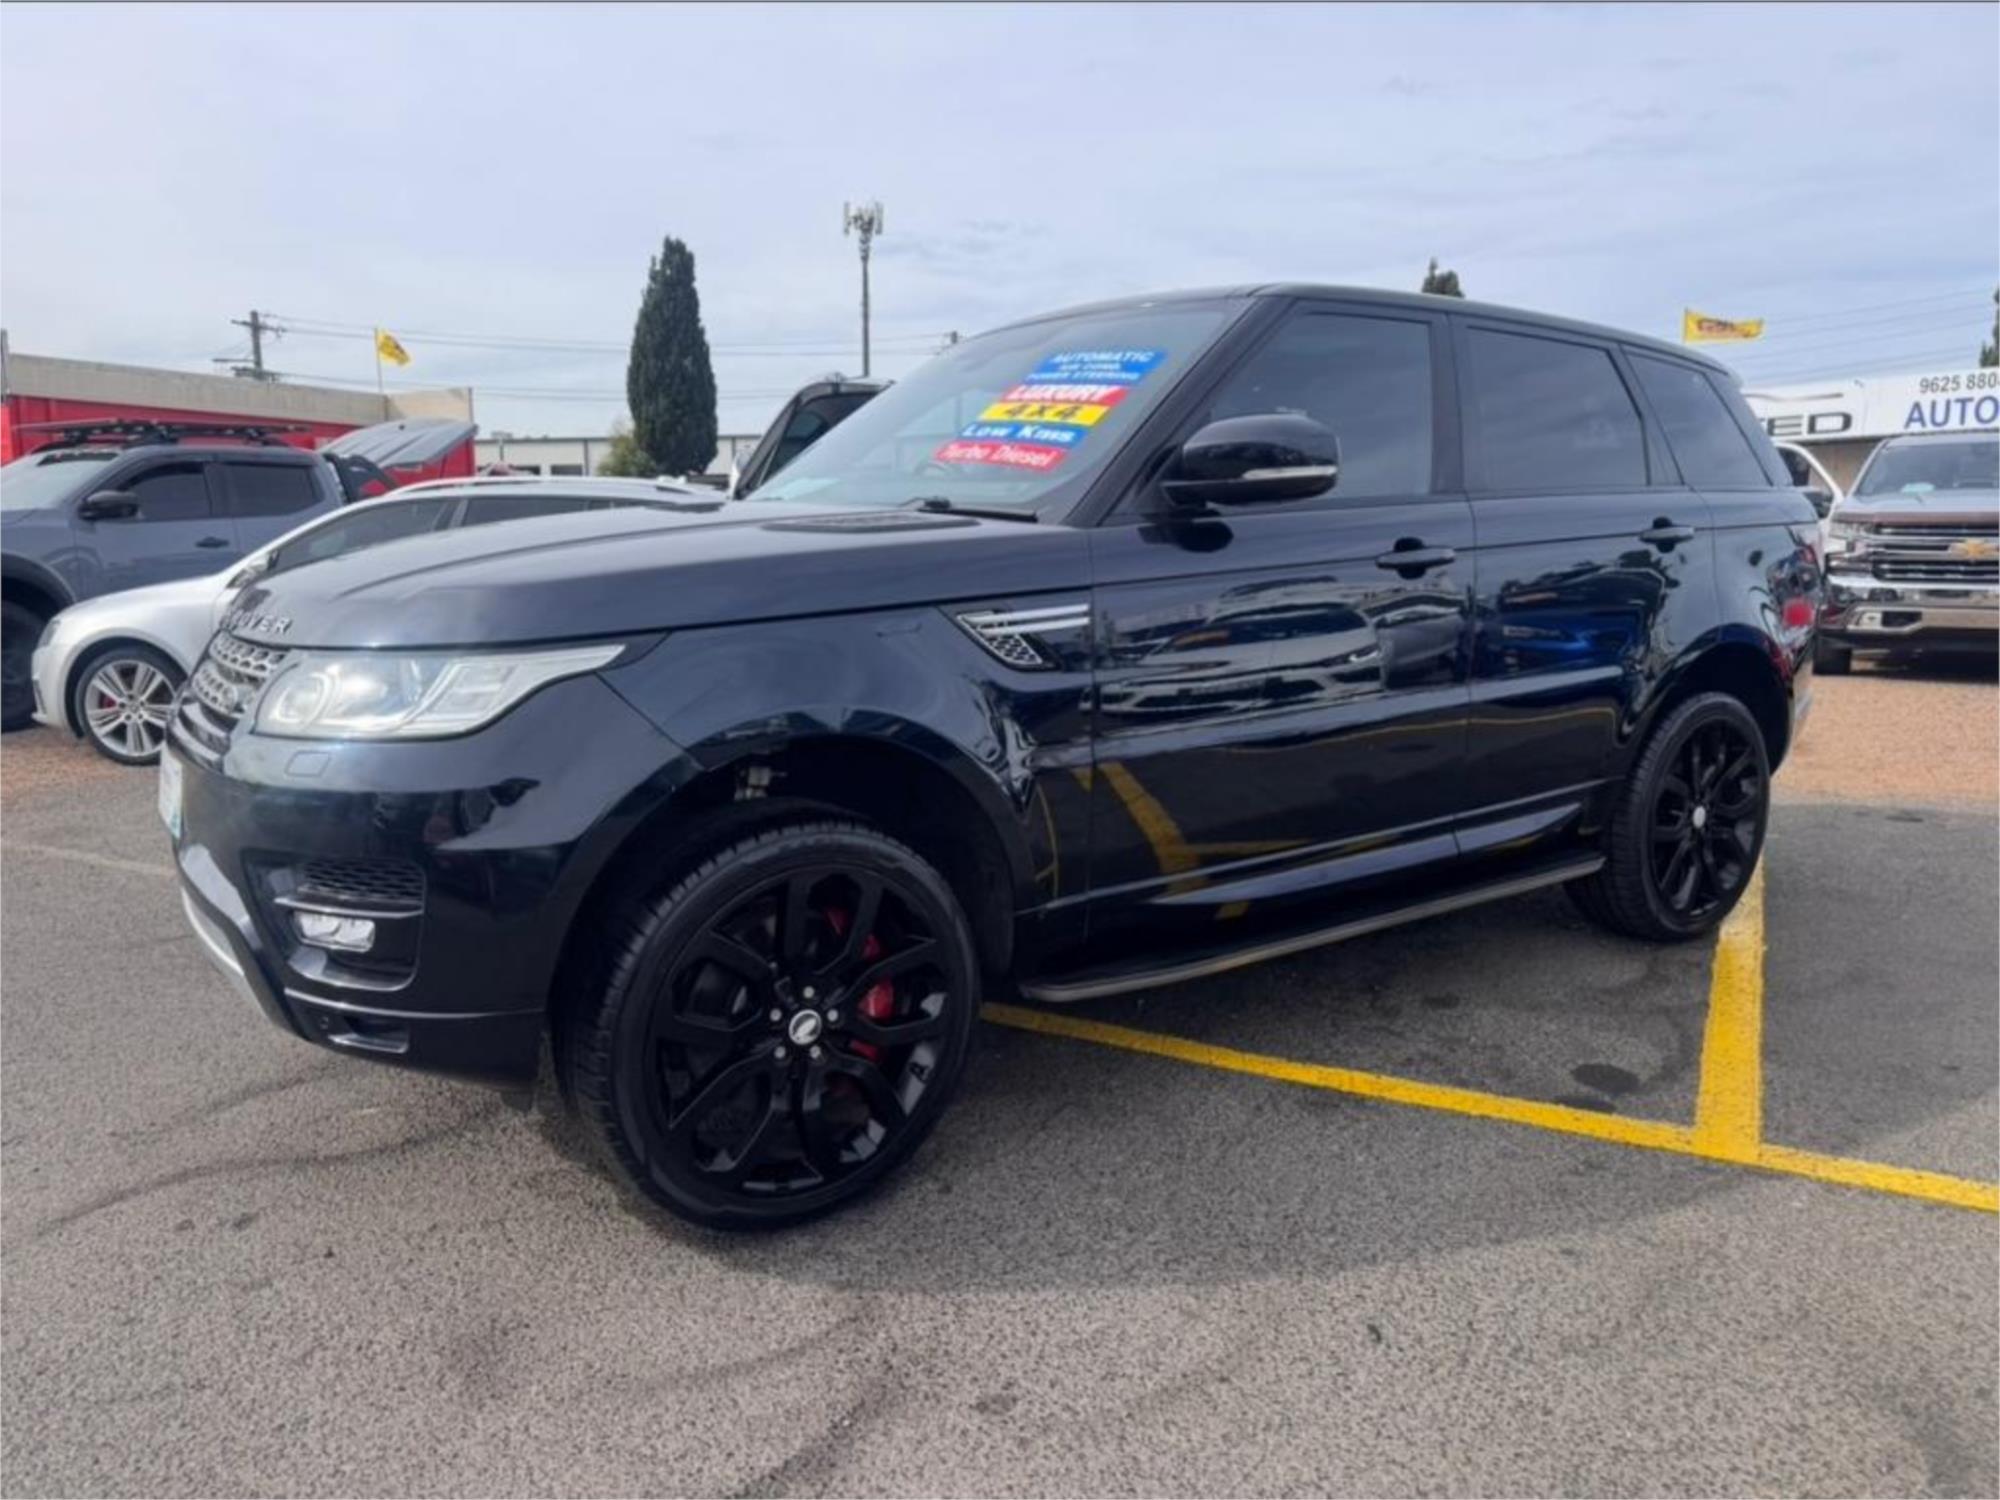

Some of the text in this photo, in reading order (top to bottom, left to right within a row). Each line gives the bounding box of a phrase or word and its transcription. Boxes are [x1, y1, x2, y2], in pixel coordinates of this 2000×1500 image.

[1052, 351, 1155, 363] AUTOMATIC
[1918, 371, 1999, 394] 9625 880
[961, 424, 1011, 437] Low
[1761, 411, 1853, 437] ED
